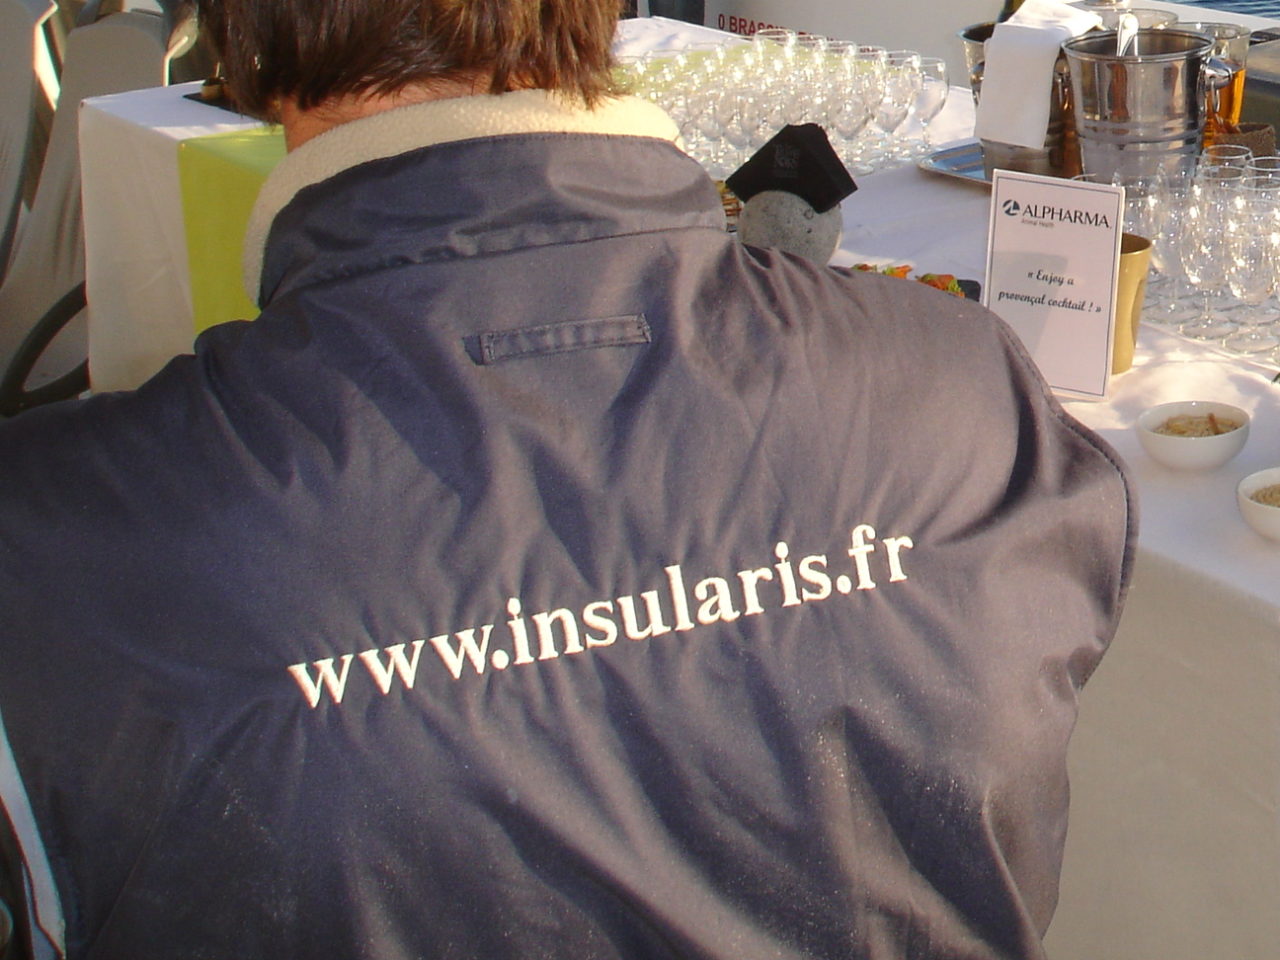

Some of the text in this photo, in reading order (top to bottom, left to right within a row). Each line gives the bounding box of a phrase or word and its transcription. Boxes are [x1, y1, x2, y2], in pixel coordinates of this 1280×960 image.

[1036, 269, 1064, 286] Enjoy
[998, 291, 1046, 306] provençal
[1047, 297, 1086, 312] cocktail
[287, 524, 914, 709] www.insularis.fr
